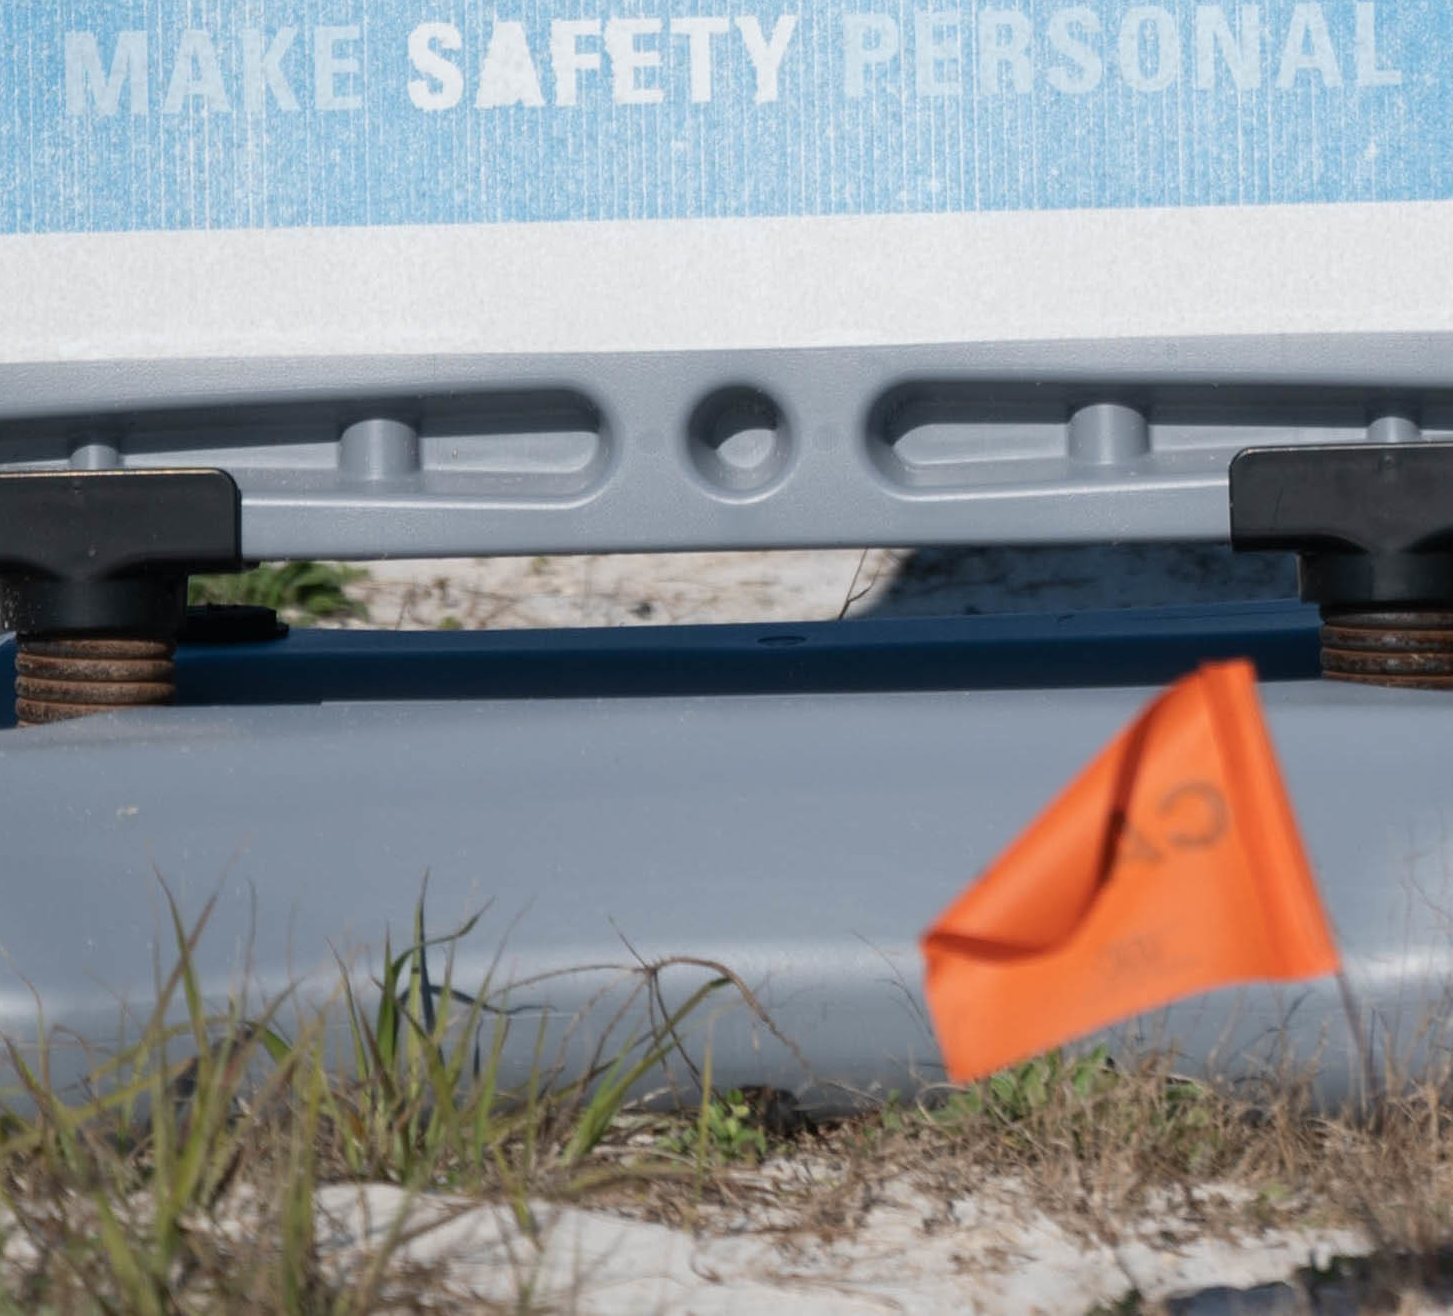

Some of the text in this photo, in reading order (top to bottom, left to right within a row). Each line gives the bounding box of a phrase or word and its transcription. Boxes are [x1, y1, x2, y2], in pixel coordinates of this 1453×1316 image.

[62, 0, 1405, 119] MAKE SAFETY PERSONAL
